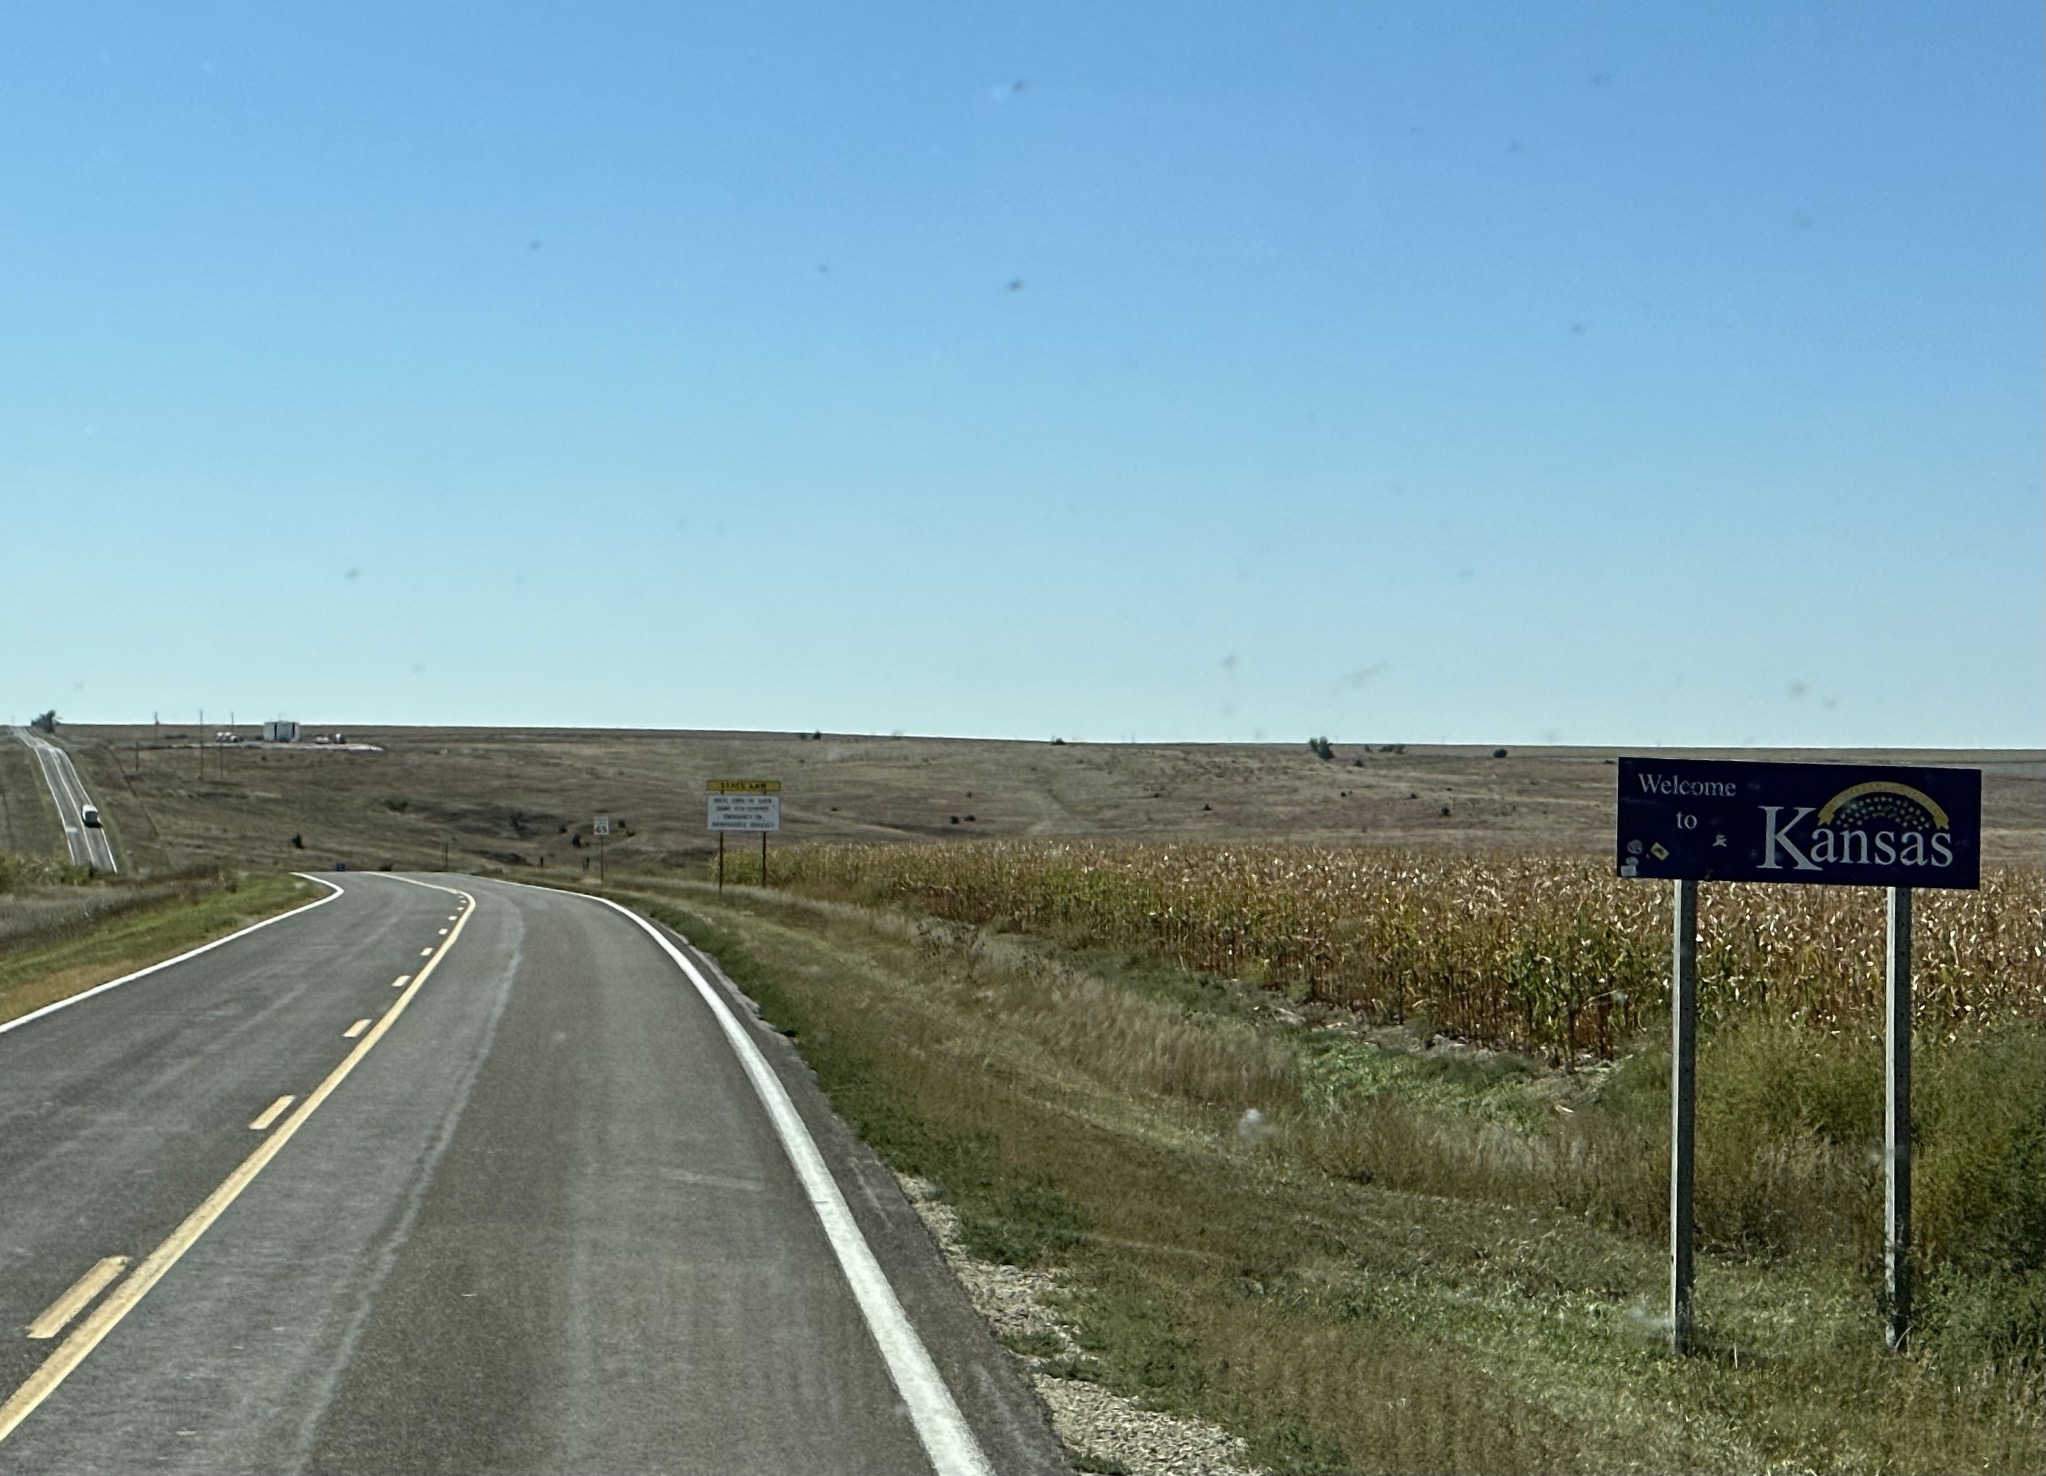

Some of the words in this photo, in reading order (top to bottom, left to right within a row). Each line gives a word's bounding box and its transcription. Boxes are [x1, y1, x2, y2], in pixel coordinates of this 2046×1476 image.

[1637, 773, 1737, 798] Welcome
[596, 825, 608, 834] 65
[1676, 811, 1698, 830] to
[1756, 805, 1954, 871] Kansas
